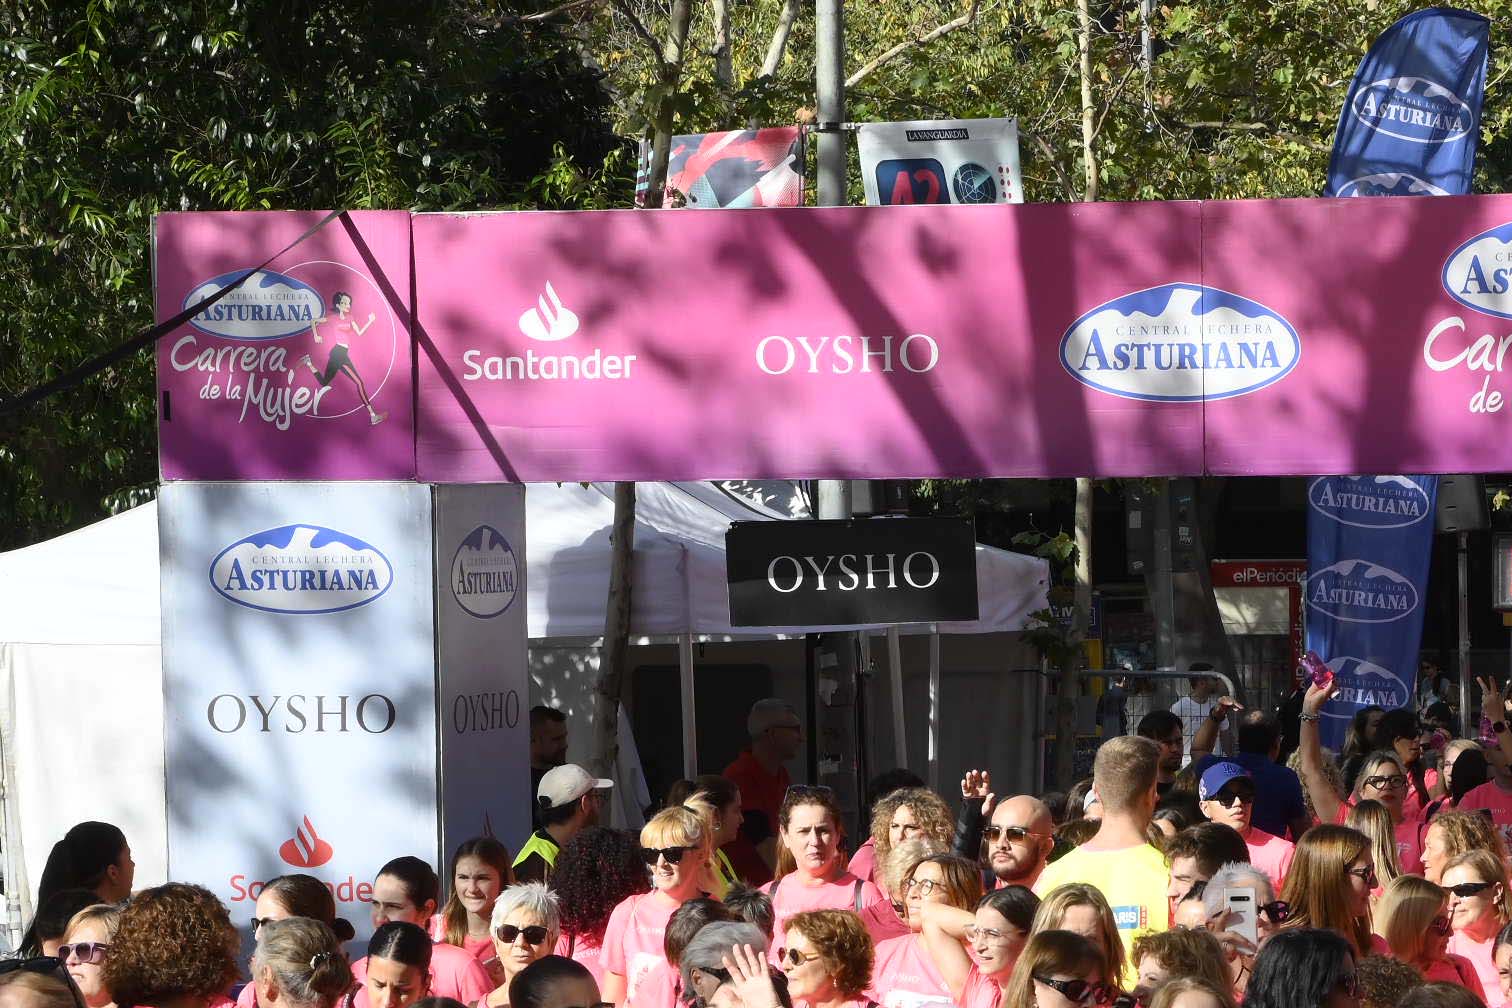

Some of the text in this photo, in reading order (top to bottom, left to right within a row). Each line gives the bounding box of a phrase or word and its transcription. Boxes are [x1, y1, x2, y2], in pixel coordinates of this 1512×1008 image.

[1360, 92, 1464, 132] ASTURIANA
[195, 295, 313, 322] ASTURIANA
[1115, 324, 1191, 336] CENTRAL
[170, 335, 288, 373] Carrera
[463, 348, 637, 381] Santander
[755, 333, 939, 376] OYSHO
[1078, 328, 1282, 371] ASTURIANA
[200, 368, 332, 431] de la Mujer
[1469, 374, 1504, 414] de
[1318, 482, 1421, 517] ASTURIANA
[223, 558, 380, 592] ASTURIANA
[252, 554, 375, 565] CENTRAL LECHERA
[767, 551, 940, 593] OYSHO
[456, 562, 514, 596] ASTURIANA
[1313, 579, 1409, 610] ASTURIANA
[207, 693, 396, 733] OYSHO
[453, 689, 520, 734] OYSHO
